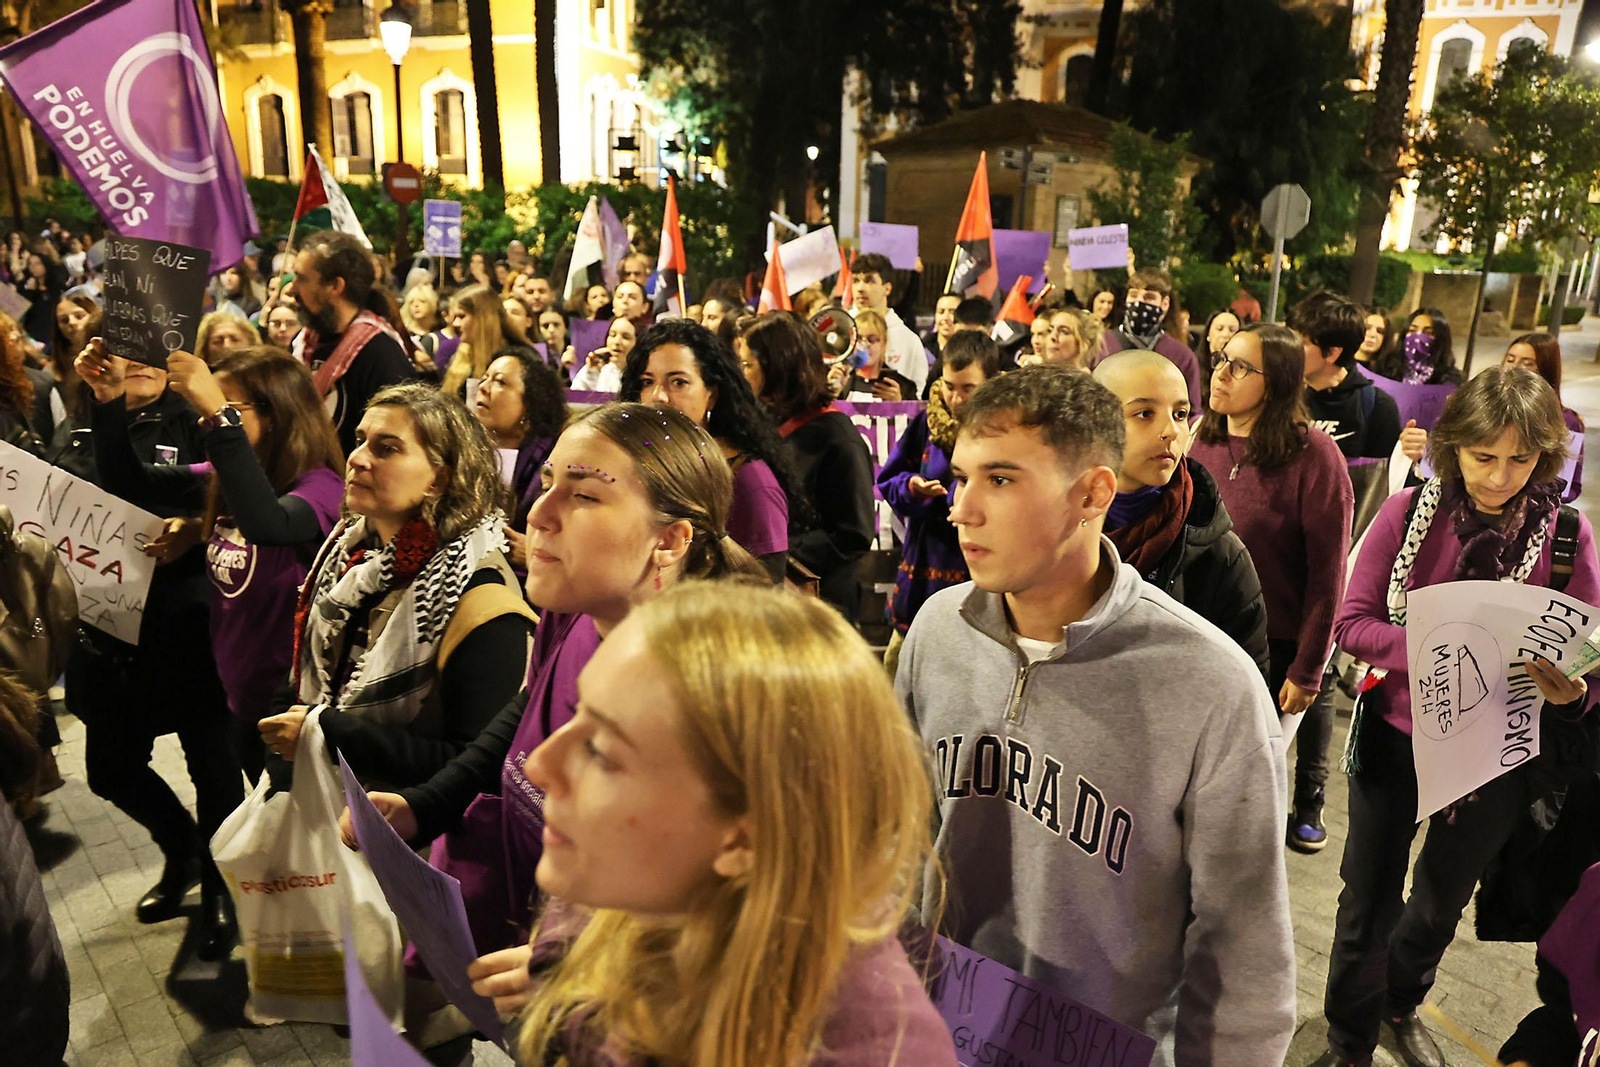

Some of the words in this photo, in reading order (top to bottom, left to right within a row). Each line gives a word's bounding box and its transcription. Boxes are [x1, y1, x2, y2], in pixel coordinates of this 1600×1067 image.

[33, 84, 149, 227] PODEMOS
[66, 85, 94, 117] EN
[88, 119, 155, 205] HUELVA
[152, 245, 196, 270] QUE
[151, 304, 190, 326] QUE
[37, 472, 151, 553] NIÑAS
[1418, 675, 1434, 715] 24H
[1431, 643, 1453, 734] MUJERES
[934, 733, 1135, 876] OLORADO
